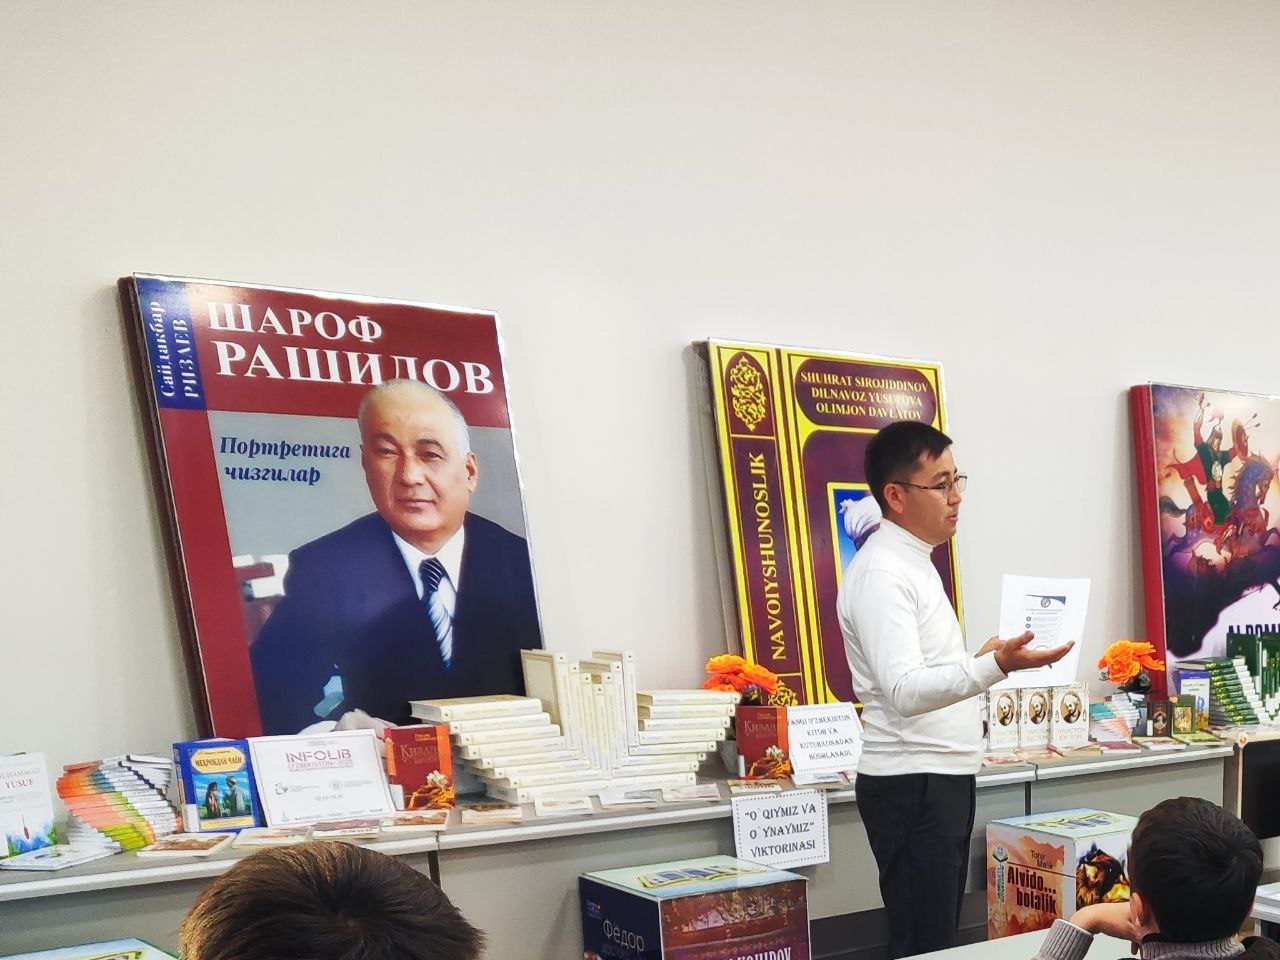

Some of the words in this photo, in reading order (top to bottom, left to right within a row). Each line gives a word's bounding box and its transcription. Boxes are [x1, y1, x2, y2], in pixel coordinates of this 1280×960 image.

[207, 301, 382, 343] ШАРОФ
[172, 318, 199, 398] РИЗАЕВ
[800, 371, 852, 387] SHUHRAT
[854, 376, 928, 393] SIROJIDDINOV
[811, 387, 867, 403] DILNAVOZ
[815, 402, 866, 416] OLIMJON
[868, 405, 922, 420] DAVLATOV
[220, 436, 351, 460] Портретига
[224, 466, 321, 486] чизгилар
[748, 451, 787, 661] NAVOIYSHUNOSLIK
[286, 749, 352, 763] INFOLIB
[5, 779, 34, 789] YUSUF
[801, 803, 817, 815] VA
[750, 839, 816, 858] VIKTORINASI
[1016, 887, 1057, 915] bolalik
